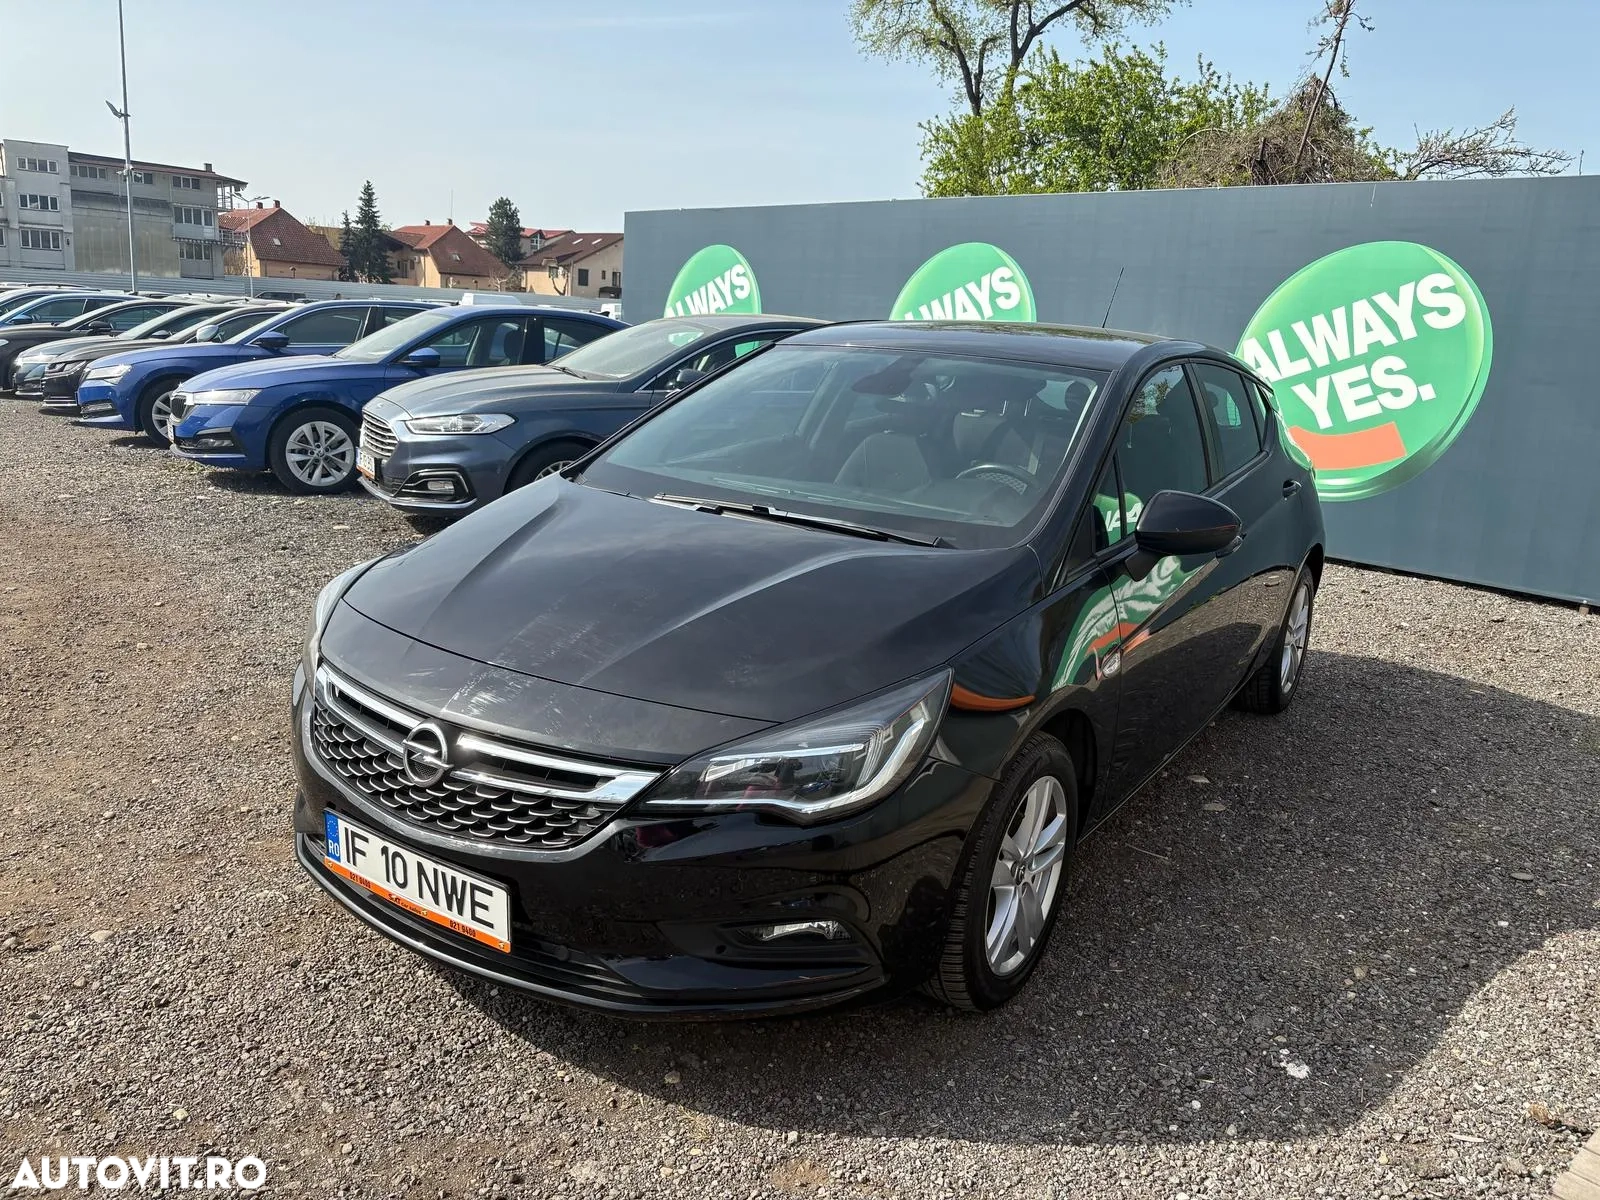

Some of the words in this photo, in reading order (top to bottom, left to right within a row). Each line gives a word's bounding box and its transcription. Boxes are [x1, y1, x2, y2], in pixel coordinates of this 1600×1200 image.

[1243, 272, 1467, 383] ALWAYS
[1291, 355, 1437, 430] YES.
[328, 840, 340, 857] RO
[344, 826, 369, 867] IF
[380, 845, 408, 890] 10
[417, 861, 494, 929] NWE
[449, 919, 460, 931] 021
